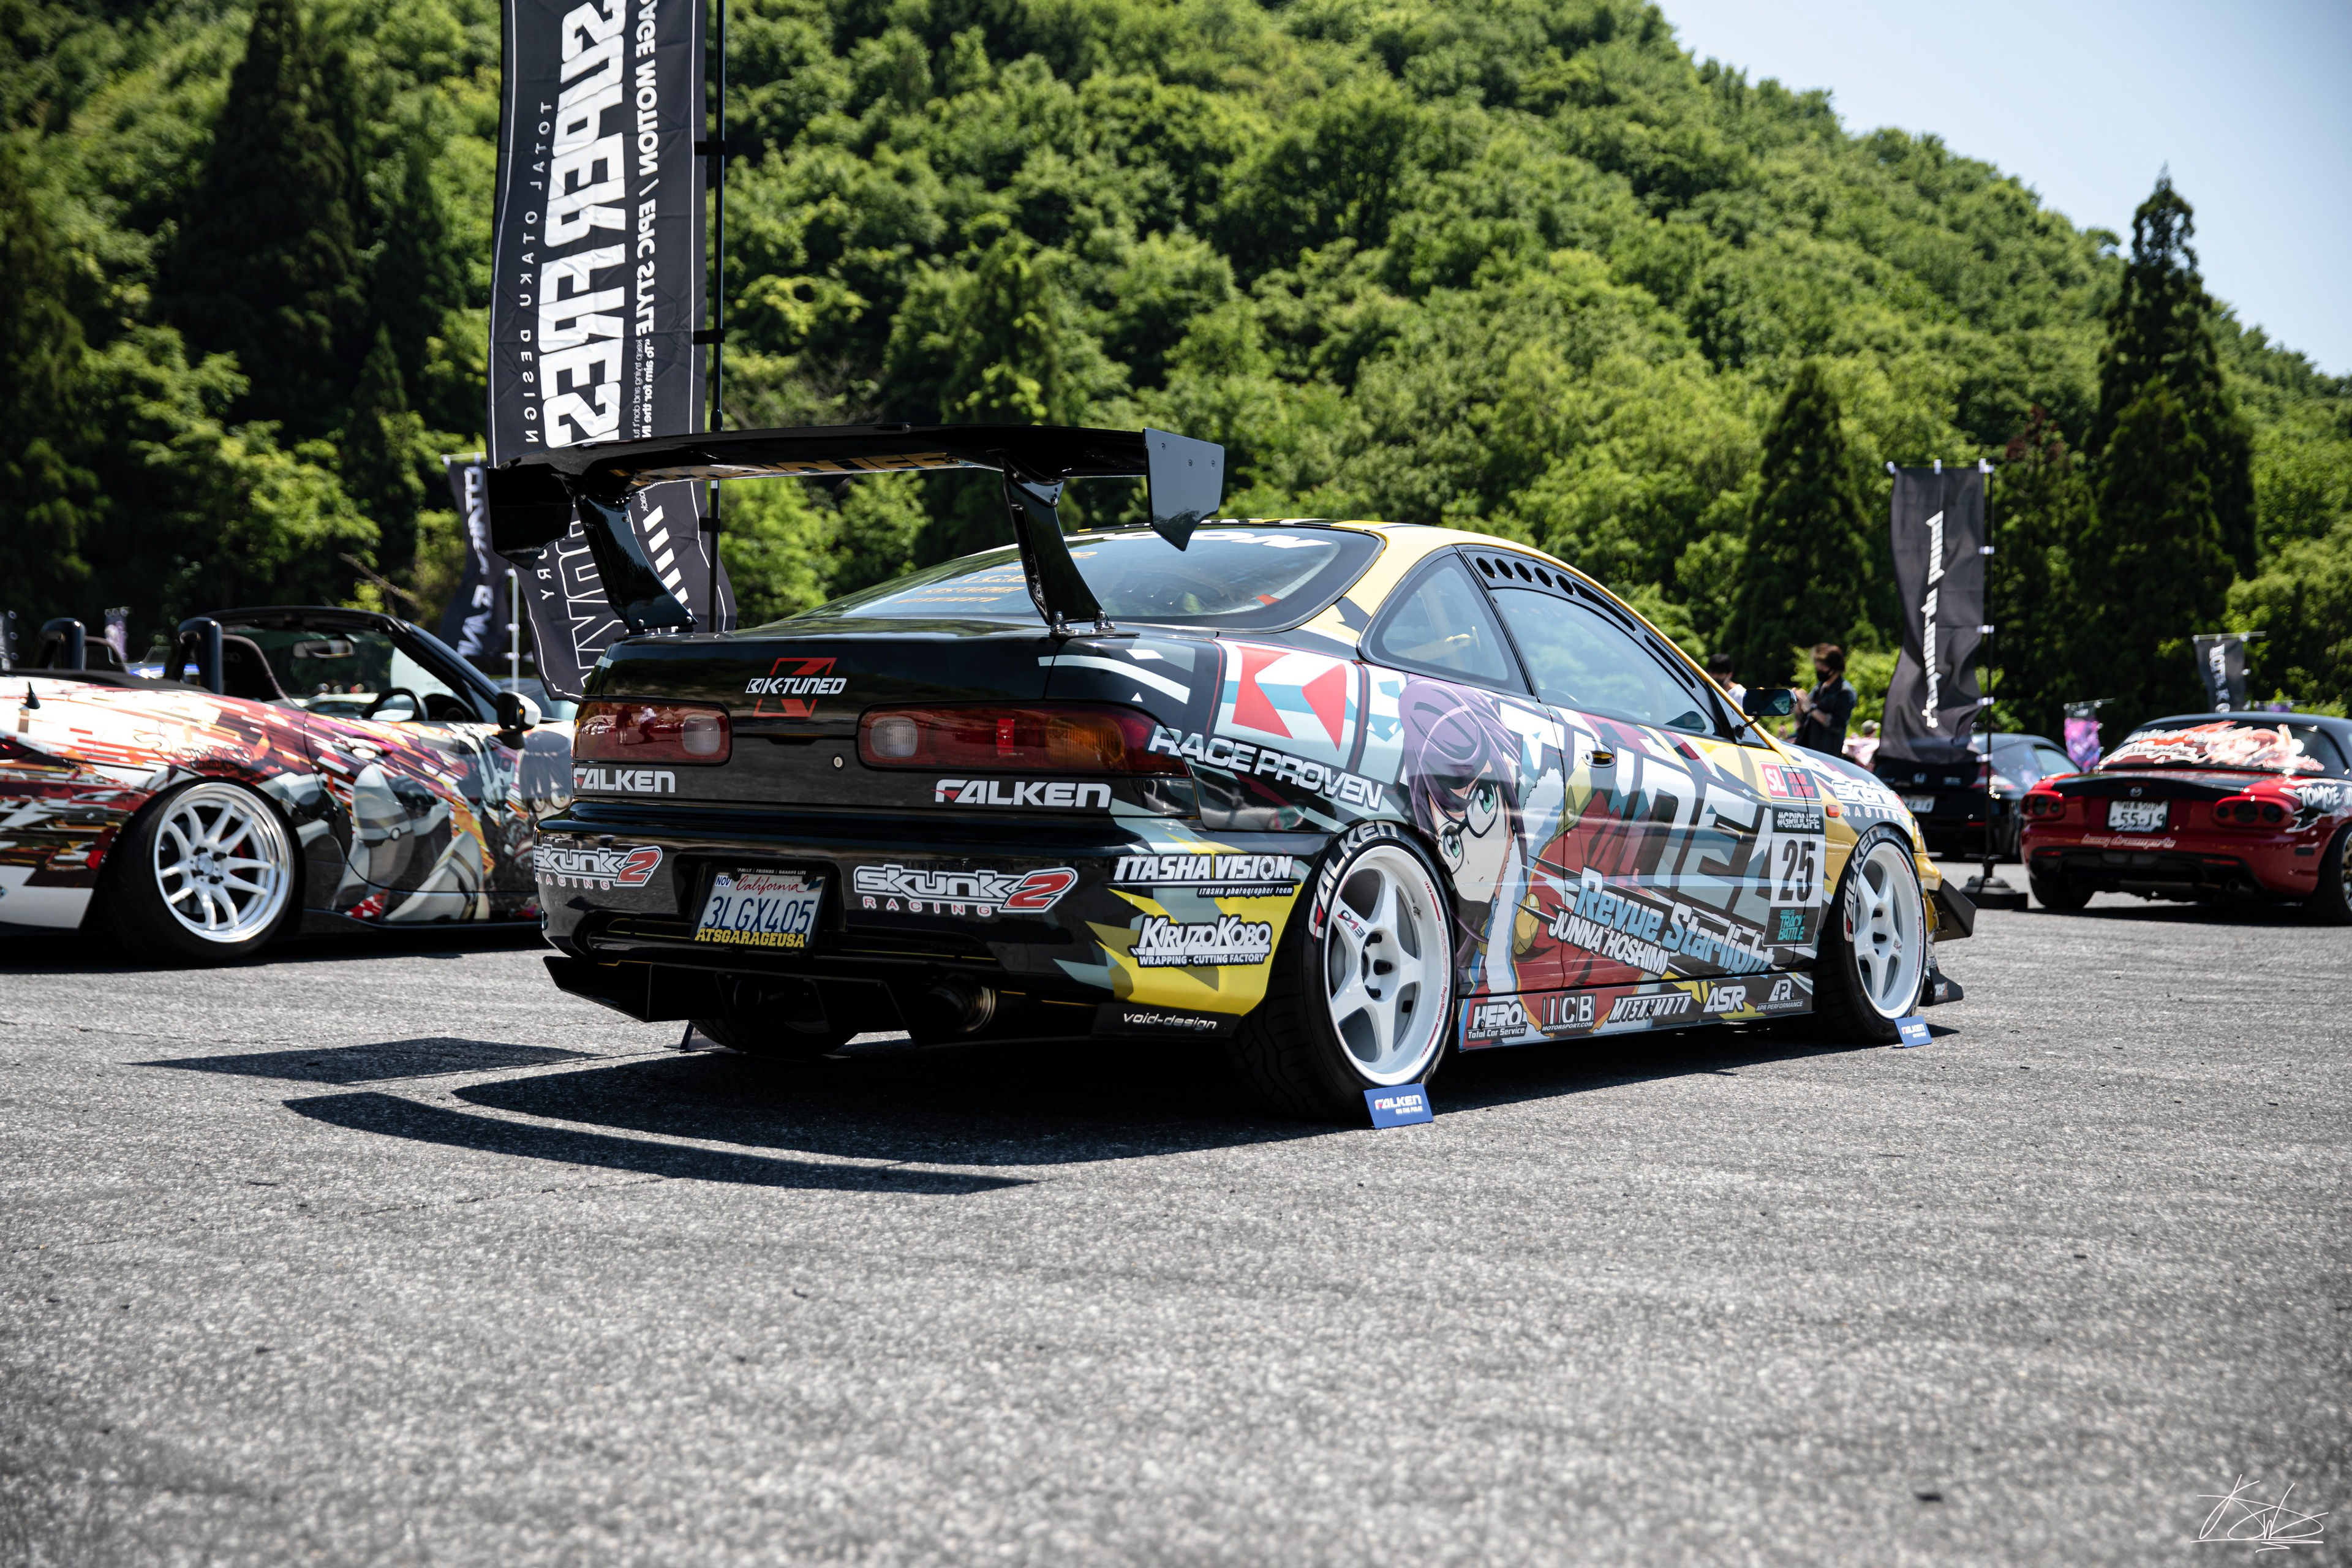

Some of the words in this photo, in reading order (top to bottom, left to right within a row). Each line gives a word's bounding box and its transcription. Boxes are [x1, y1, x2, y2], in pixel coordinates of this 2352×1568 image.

[761, 677, 847, 695] K-TUNED
[1148, 726, 1257, 772] RACE
[1253, 748, 1384, 810] PROVEN
[573, 768, 676, 793] FALKEN
[1765, 767, 1787, 792] SL
[1787, 772, 1807, 785] STAR
[932, 779, 1112, 808] FALKEN
[1844, 805, 1899, 821] RACING
[1308, 820, 1398, 939] FALKEN
[1778, 839, 1816, 902] 25
[535, 872, 612, 891] RACING
[715, 875, 733, 887] NOV
[736, 875, 805, 895] California
[1843, 825, 1882, 942] FALKEN
[1225, 887, 1274, 896] photographer
[703, 895, 815, 934] 3LGX405
[862, 895, 993, 917] RACING
[1574, 866, 1665, 942] Revue
[1664, 902, 1775, 979] Starlight
[1548, 908, 1604, 952] JUNNA
[1604, 931, 1670, 976] HOSHIMI
[1777, 926, 1805, 941] BATTLE
[1139, 955, 1187, 965] WRAPPING
[1193, 954, 1227, 964] CUTTING
[1229, 953, 1265, 963] FACTORY
[1703, 985, 1746, 1013] ASR
[1767, 1001, 1804, 1011] PERFORMANCE
[1123, 1011, 1218, 1030] void-design
[1472, 1003, 1524, 1030] HERO
[1542, 1021, 1594, 1031] MOTORSPORT.COM
[1468, 1030, 1485, 1039] Total
[1486, 1028, 1499, 1038] Car
[1499, 1027, 1525, 1036] Service
[1374, 1094, 1422, 1110] FALKEN
